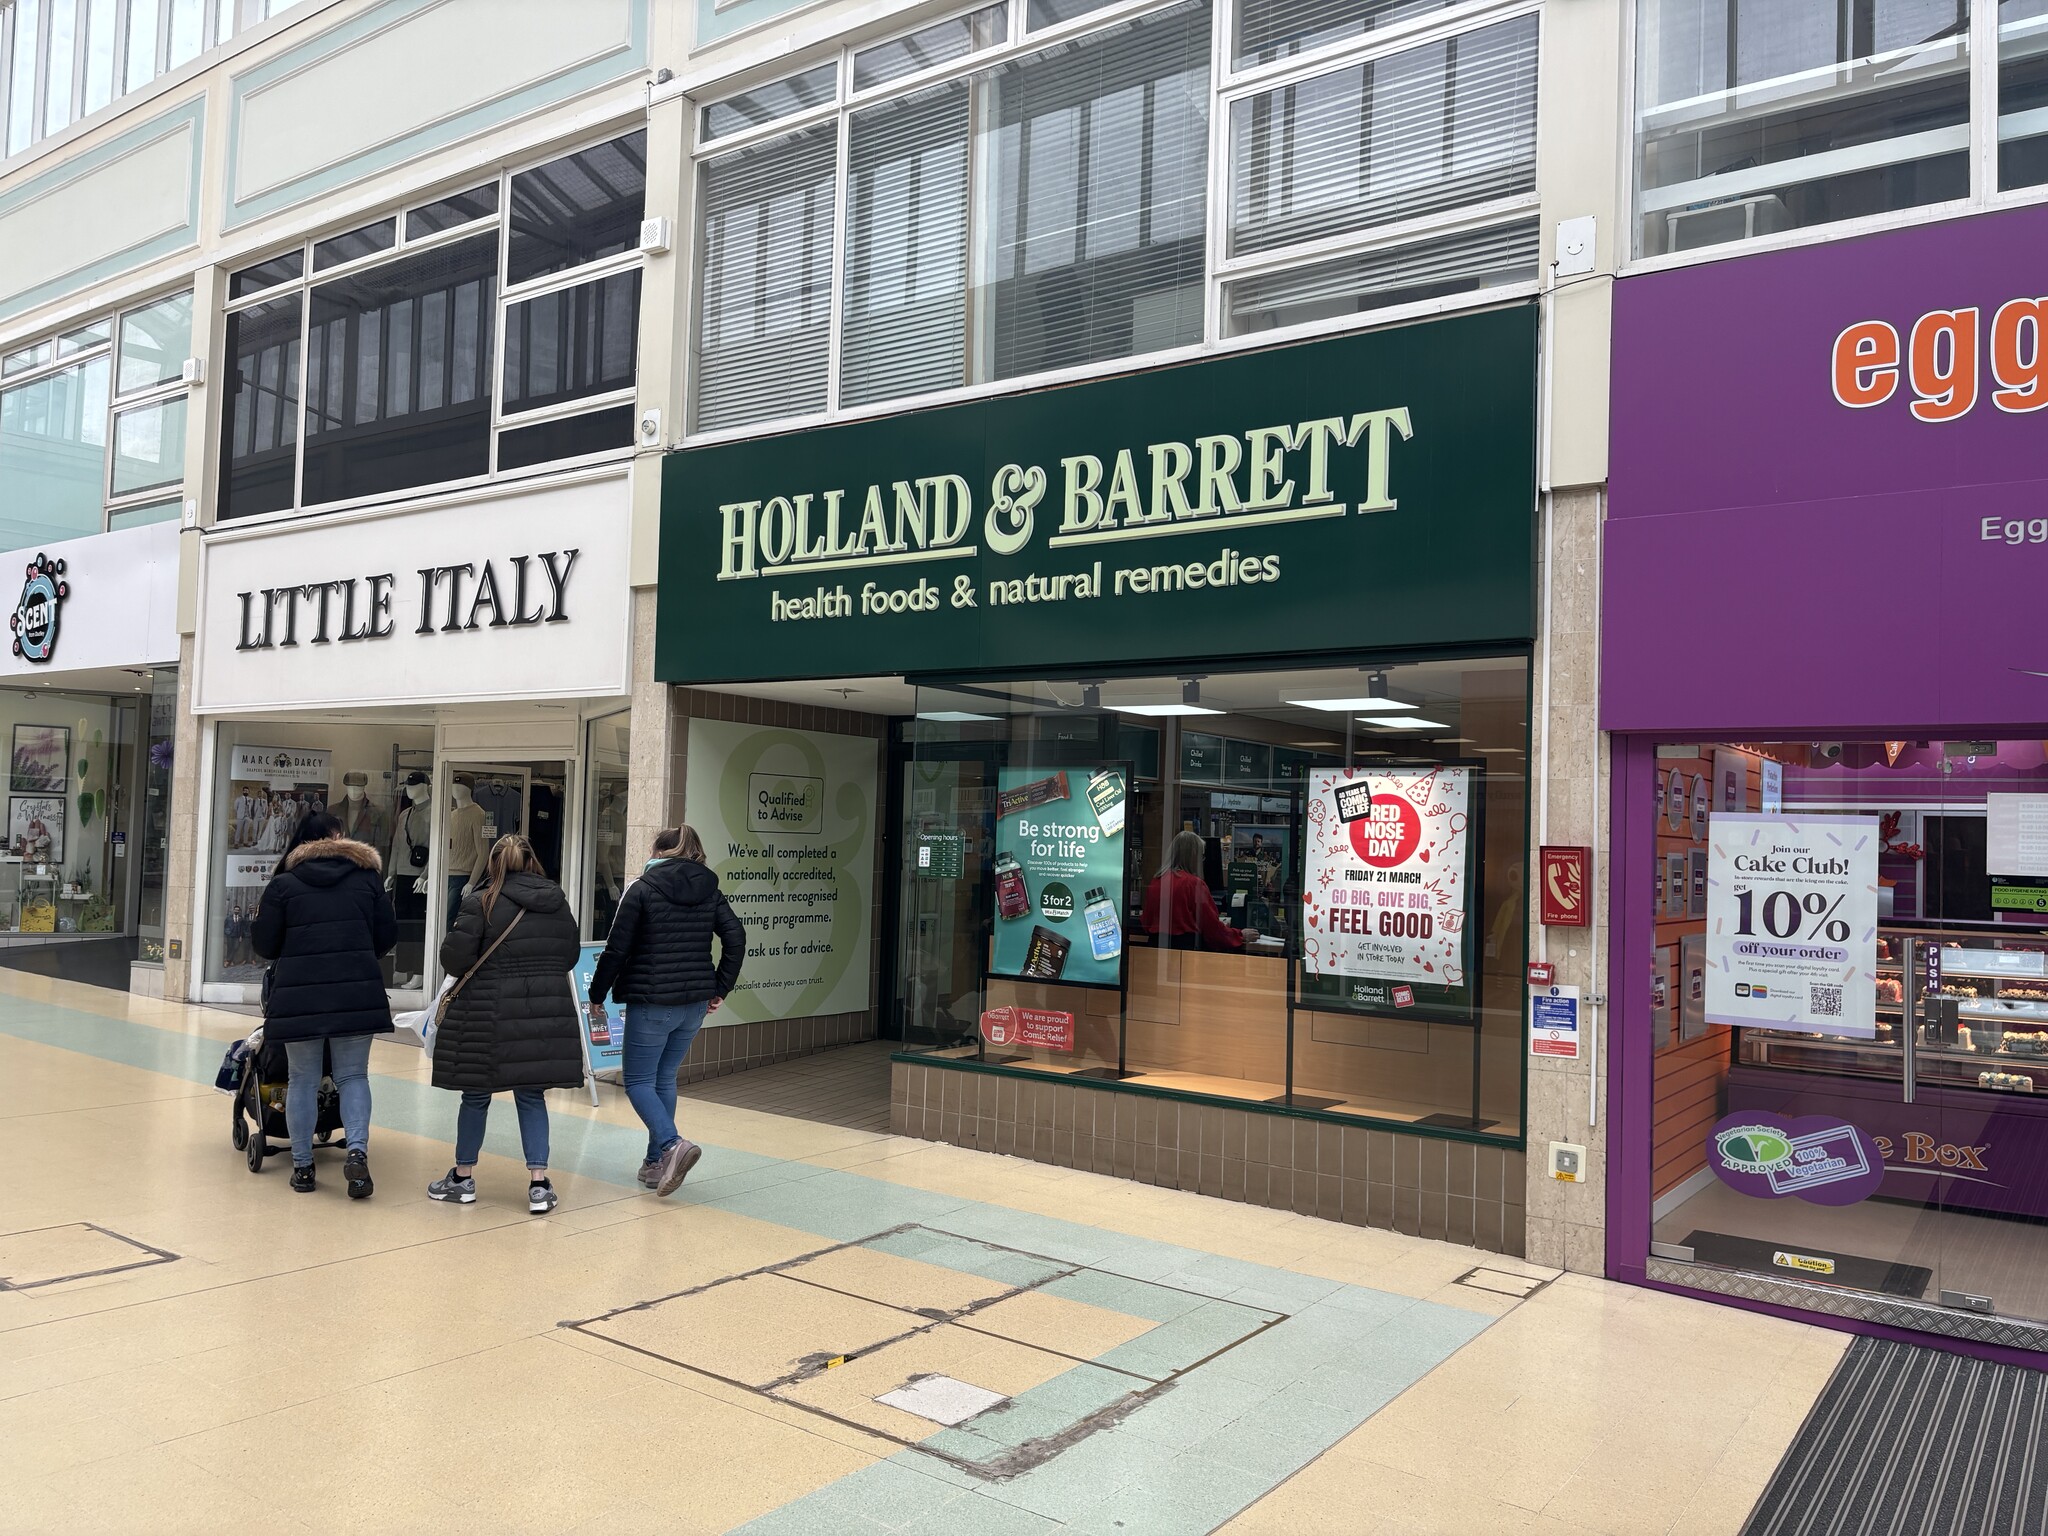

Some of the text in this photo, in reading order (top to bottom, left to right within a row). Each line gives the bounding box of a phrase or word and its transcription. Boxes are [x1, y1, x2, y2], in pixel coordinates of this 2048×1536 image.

[717, 406, 1414, 581] HOLLAND & BARRETT
[771, 547, 1281, 622] health foods & natural remedies
[236, 548, 579, 650] LITTLE ITALY
[17, 598, 58, 637] SCENT
[242, 754, 323, 767] MARC DARCY
[759, 790, 806, 807] Qualified
[1345, 788, 1360, 797] YEARS
[19, 800, 53, 812] Crystals
[1001, 795, 1029, 808] TriActive
[1340, 793, 1369, 809] COMIC
[25, 810, 58, 821] Wellness
[757, 807, 803, 822] to Advise
[1342, 803, 1370, 819] RELIEF
[1370, 804, 1401, 822] RED
[920, 834, 943, 842] Opening
[1019, 819, 1039, 837] Be
[1042, 821, 1100, 844] strong
[1364, 821, 1406, 840] NOSE
[728, 843, 837, 864] We've all completed a
[1031, 841, 1086, 859] for life
[1368, 839, 1400, 858] DAY
[1771, 845, 1791, 855] Join
[1547, 853, 1579, 862] Emergency
[1734, 854, 1849, 876] Cake Club!
[727, 866, 836, 886] nationally accredited,
[1345, 869, 1421, 884] FRIDAY 21 MARCH
[1734, 884, 1746, 892] get
[787, 888, 838, 907] recognised
[1043, 894, 1072, 906] 3 for 2
[1332, 889, 1432, 911] GO BIG, GIVE BIG,
[738, 912, 832, 930] aining programme.
[1329, 908, 1433, 939] FEEL GOOD
[1734, 889, 1851, 942] 10%
[748, 940, 833, 958] ask us for advice.
[1357, 942, 1403, 953] GET INVOLVED
[1740, 942, 1841, 960] off your order
[1357, 953, 1405, 964] IN STORE TODAY
[1929, 946, 1938, 989] PUSH
[734, 980, 761, 993] pecialist
[761, 978, 782, 988] advice
[783, 980, 795, 990] you
[796, 978, 808, 986] can
[1354, 984, 1384, 995] Holland
[1022, 1012, 1033, 1020] We
[1047, 1015, 1069, 1024] proud
[1022, 1030, 1067, 1042] Comic Relief
[1035, 1023, 1063, 1033] support
[1717, 1126, 1785, 1141] Vegetarian Society
[1795, 1147, 1826, 1162] 100%
[1902, 1131, 1988, 1171] Box
[1723, 1158, 1792, 1173] APPROVED
[1787, 1158, 1845, 1176] Vegetarian
[1797, 1258, 1827, 1268] Caution
